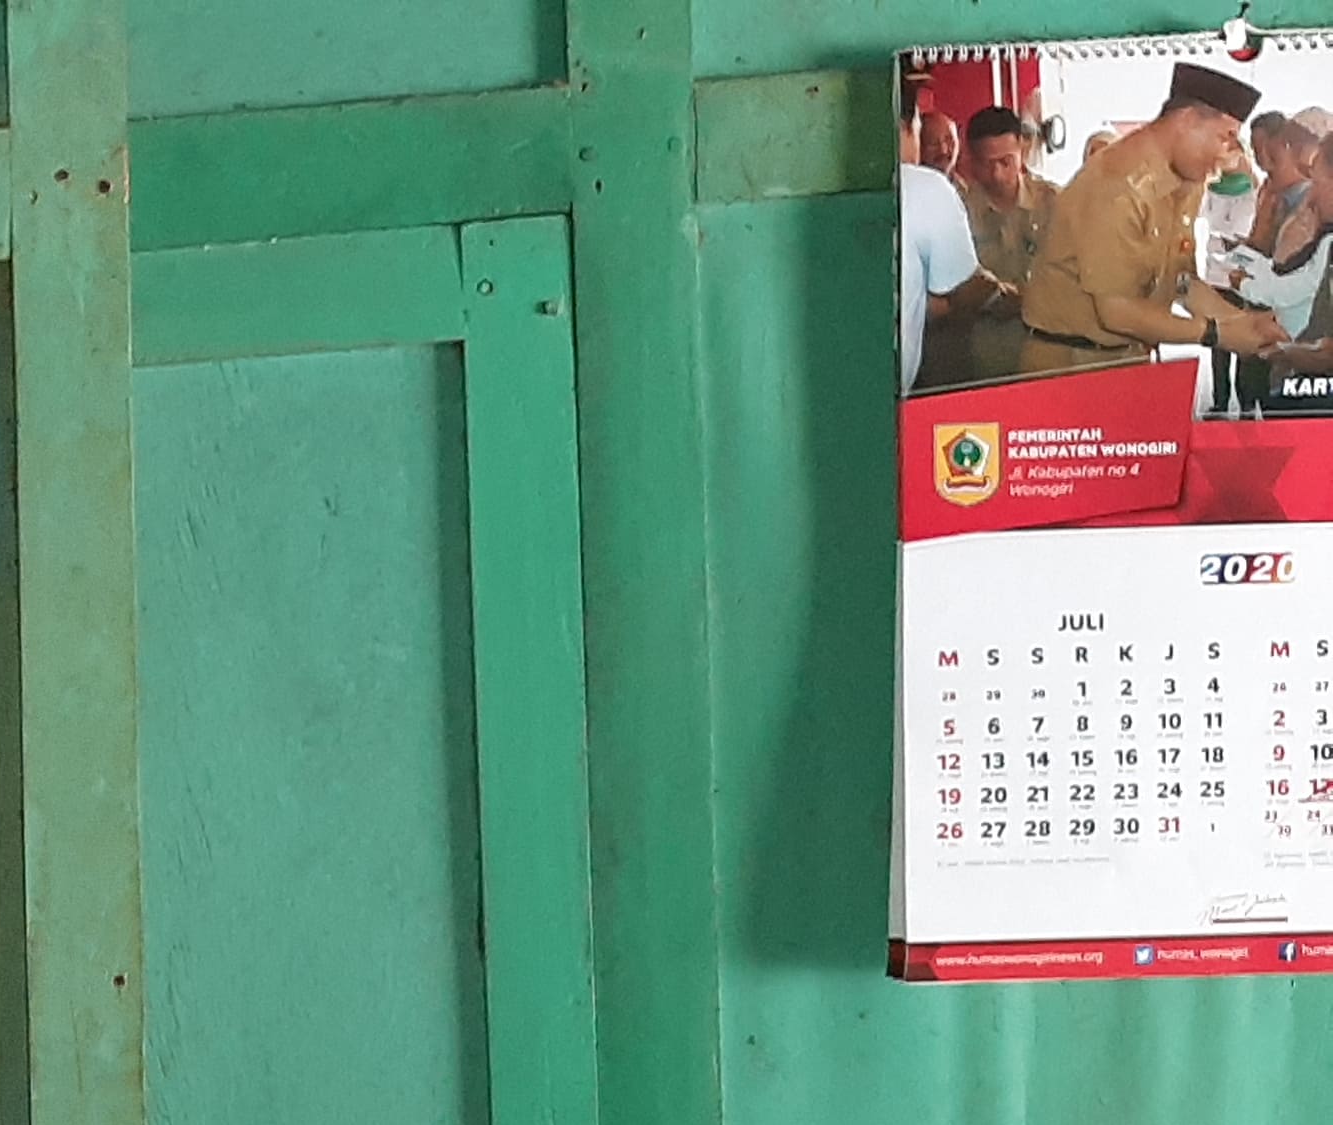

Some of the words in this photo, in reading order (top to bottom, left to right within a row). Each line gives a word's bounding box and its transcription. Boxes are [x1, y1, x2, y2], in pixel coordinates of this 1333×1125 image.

[1007, 427, 1103, 443] PEMERINTAH
[1007, 444, 1098, 459] KABUPATEN
[1100, 441, 1178, 457] WONOGIRI
[1200, 552, 1296, 585] 2020
[1058, 613, 1104, 632] JULI
[938, 650, 959, 667] M
[986, 648, 1000, 666] S
[1031, 647, 1044, 665] S
[1075, 646, 1089, 663] R
[1119, 644, 1133, 662] K
[1164, 643, 1174, 661] J
[1207, 641, 1221, 660] S
[1270, 641, 1290, 658] M
[1316, 639, 1329, 657] S
[1076, 681, 1087, 698] 1
[1120, 679, 1133, 697] 2
[1164, 678, 1176, 695] 3
[1207, 677, 1220, 694] 4
[943, 719, 955, 737] 5
[987, 717, 1001, 735] 6
[1032, 716, 1045, 734] 7
[1076, 715, 1089, 732] 8
[1120, 714, 1133, 731] 9
[1158, 712, 1182, 730] 10
[1203, 712, 1223, 729] 11
[1273, 710, 1286, 727] 2
[1316, 708, 1328, 726] 3
[937, 753, 961, 771] 12
[981, 751, 1006, 770] 13
[1026, 751, 1050, 769] 14
[1070, 749, 1094, 767] 15
[1114, 748, 1138, 767] 16
[1157, 747, 1181, 765] 17
[1201, 746, 1224, 763] 18
[1272, 744, 1286, 762] 9
[937, 787, 962, 805] 19
[980, 786, 1008, 804] 20
[1026, 785, 1049, 803] 21
[1069, 784, 1096, 802] 22
[1113, 783, 1139, 800] 23
[1157, 782, 1183, 799] 24
[1200, 780, 1225, 798] 25
[1266, 779, 1290, 796] 16
[936, 822, 964, 840] 26
[980, 821, 1007, 839] 27
[1024, 820, 1051, 837] 28
[1069, 818, 1096, 836] 29
[1113, 817, 1140, 835] 30
[1158, 816, 1180, 834] 31
